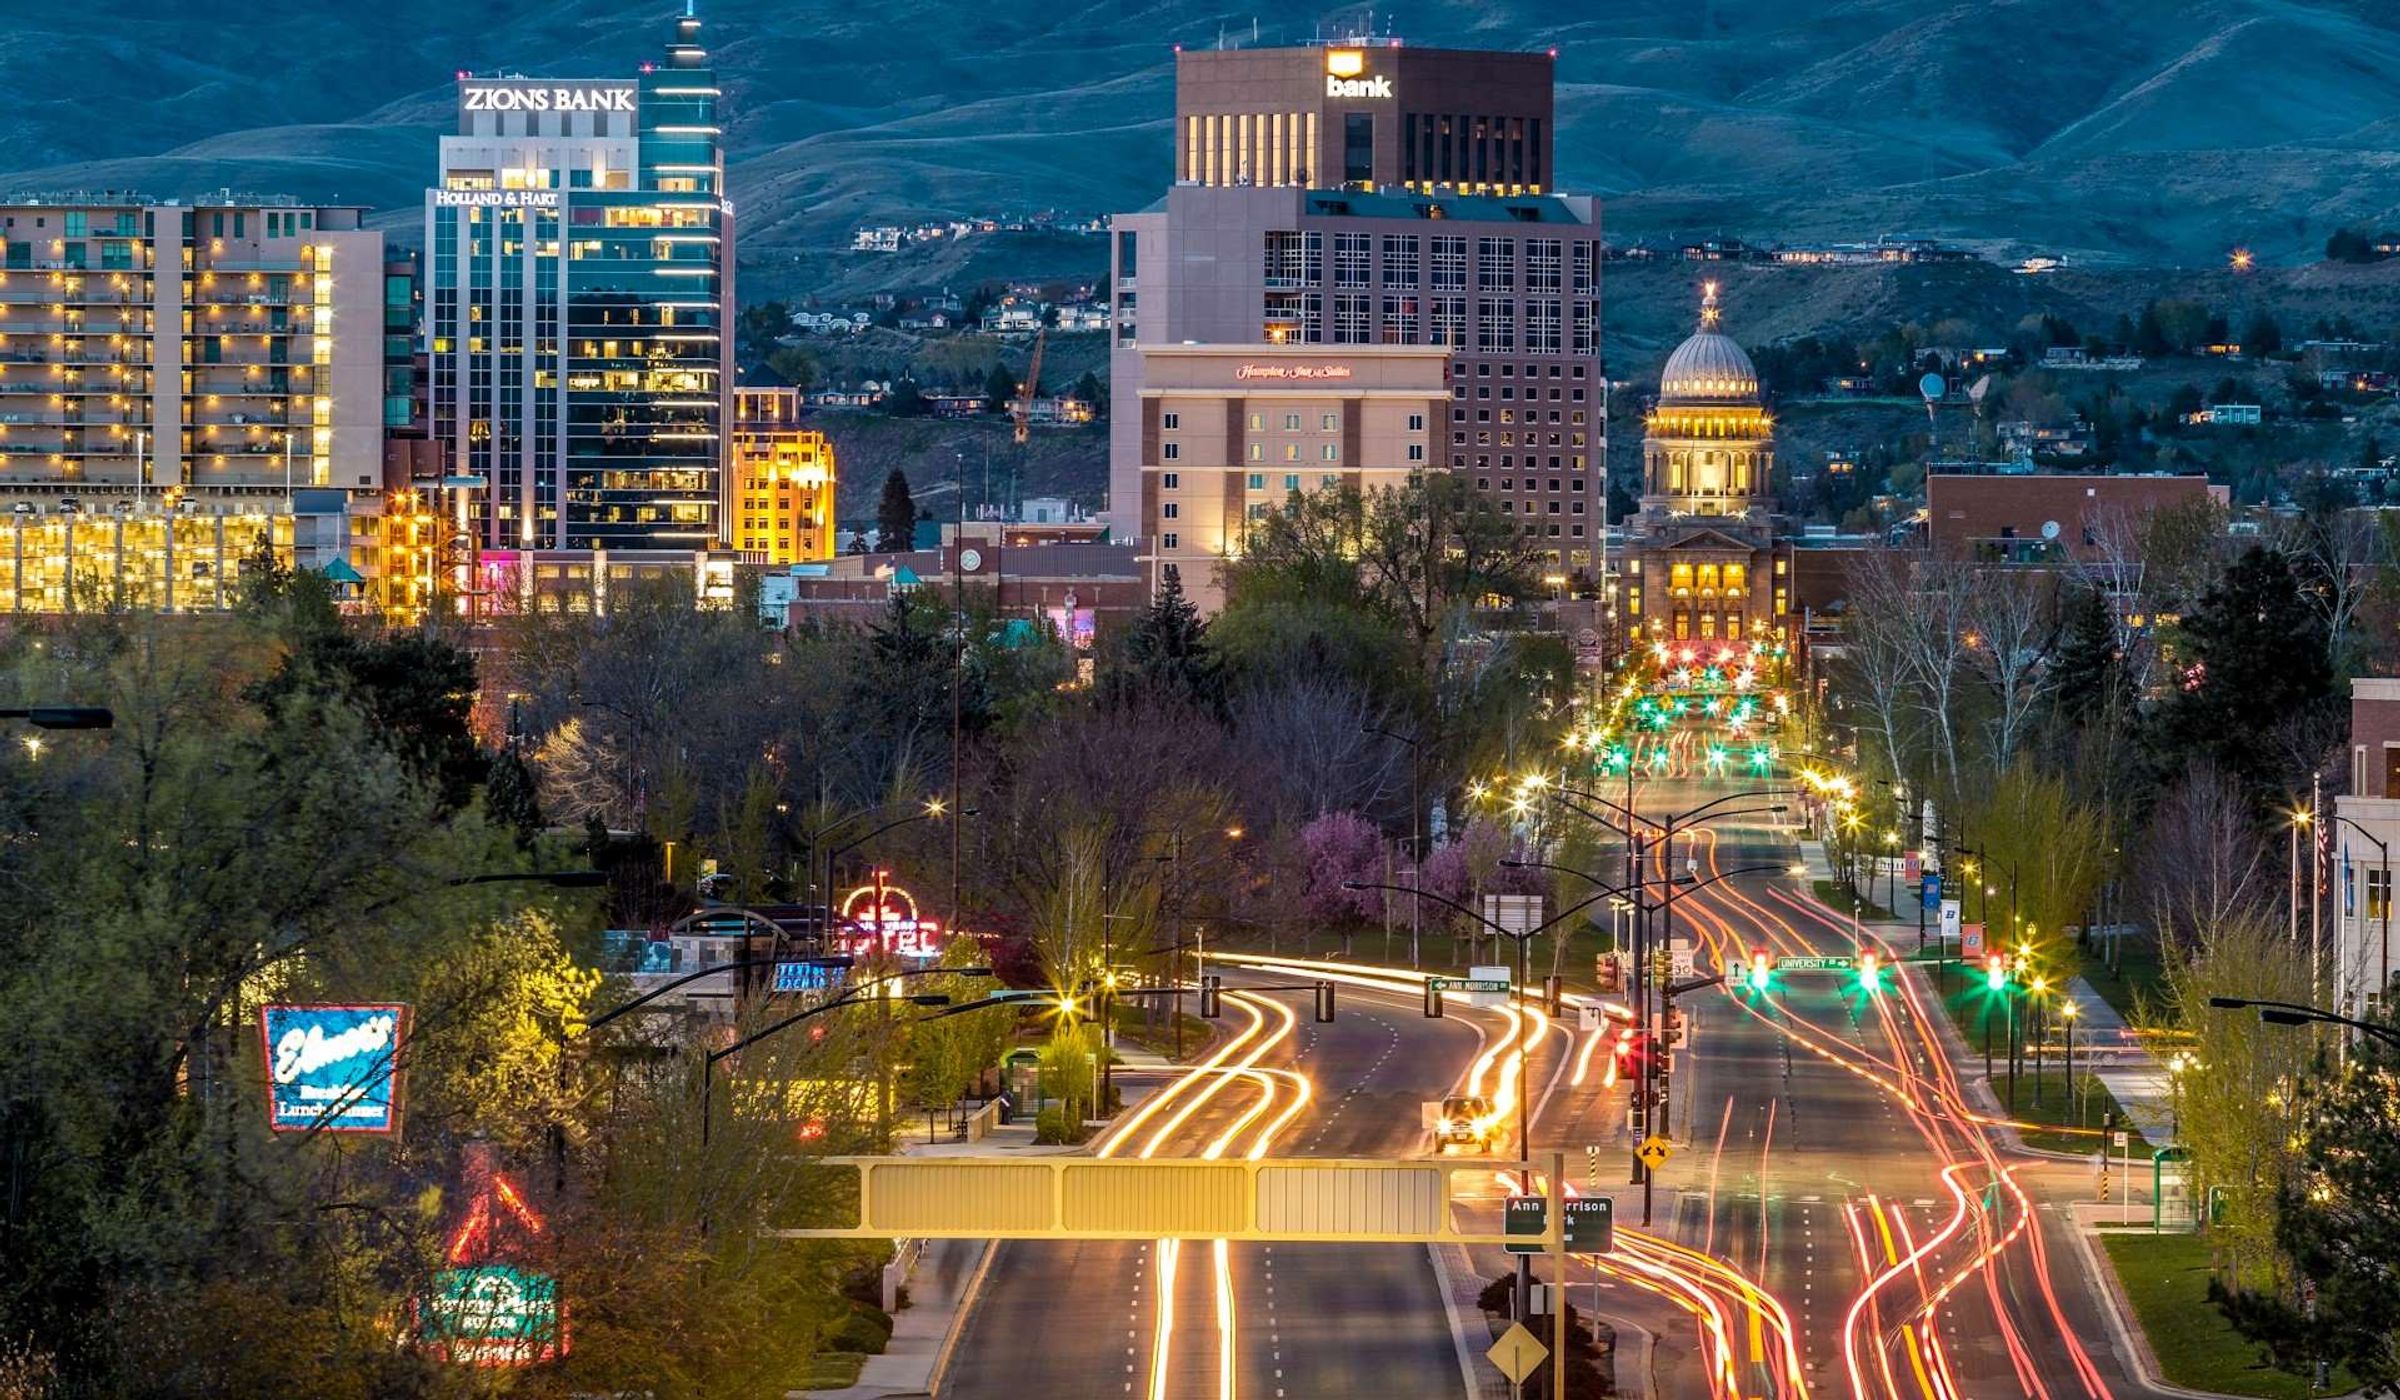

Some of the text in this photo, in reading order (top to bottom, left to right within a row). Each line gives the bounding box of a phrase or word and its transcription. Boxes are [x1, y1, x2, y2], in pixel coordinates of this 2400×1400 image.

[1327, 75, 1392, 97] bank
[464, 88, 636, 111] ZIONS BANK
[504, 192, 517, 205] &
[1237, 364, 1289, 379] Hampton
[1674, 965, 1690, 974] 30
[1781, 958, 1825, 969] UNIVERSITY
[1449, 981, 1462, 991] ANN
[1465, 981, 1498, 991] MORRISON
[1511, 1200, 1607, 1212] Ann rrison
